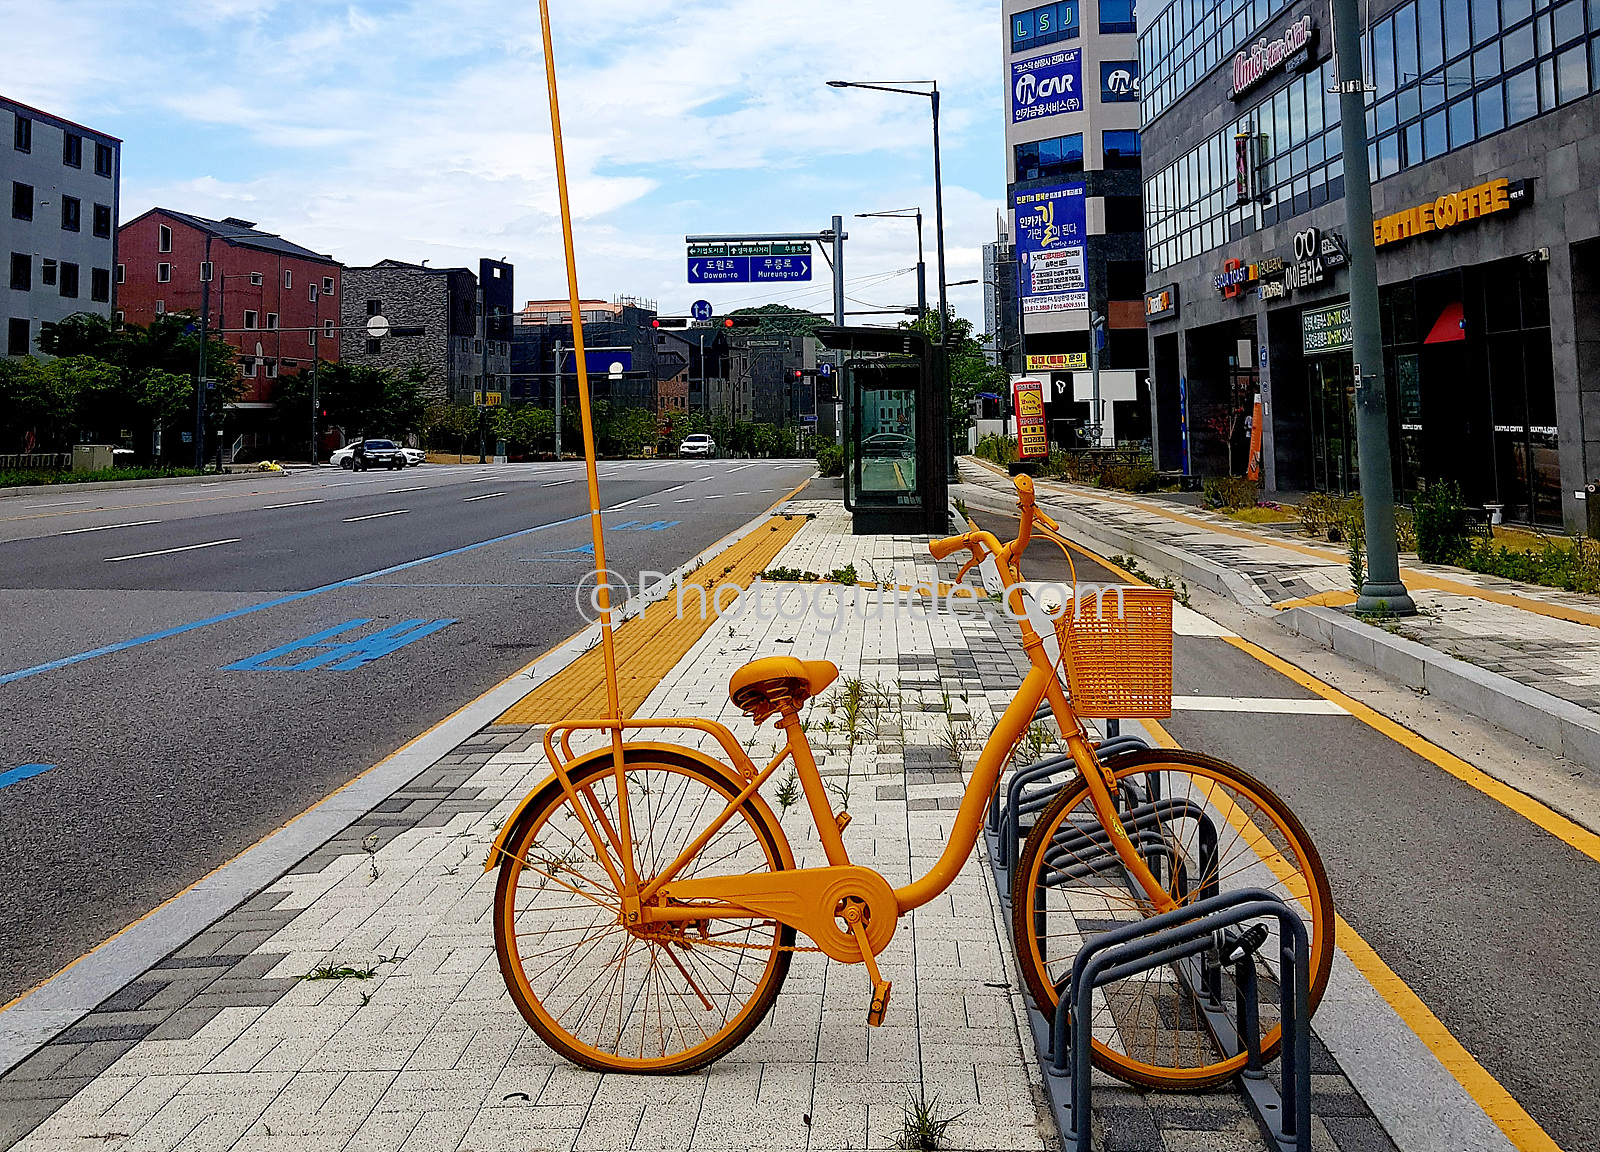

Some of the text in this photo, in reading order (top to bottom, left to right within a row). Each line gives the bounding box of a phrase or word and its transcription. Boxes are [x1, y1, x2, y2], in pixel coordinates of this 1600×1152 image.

[1373, 178, 1510, 247] EATTLE COFFEE
[1019, 215, 1042, 228] 인카가
[1027, 228, 1042, 240] 가면
[1062, 223, 1077, 236] 된다
[706, 260, 735, 271] 도원로
[764, 259, 793, 270] 무릉로
[703, 271, 739, 279] Dowon-ro
[757, 271, 799, 279] Mureung-ro
[1285, 258, 1324, 290] 아이글라스
